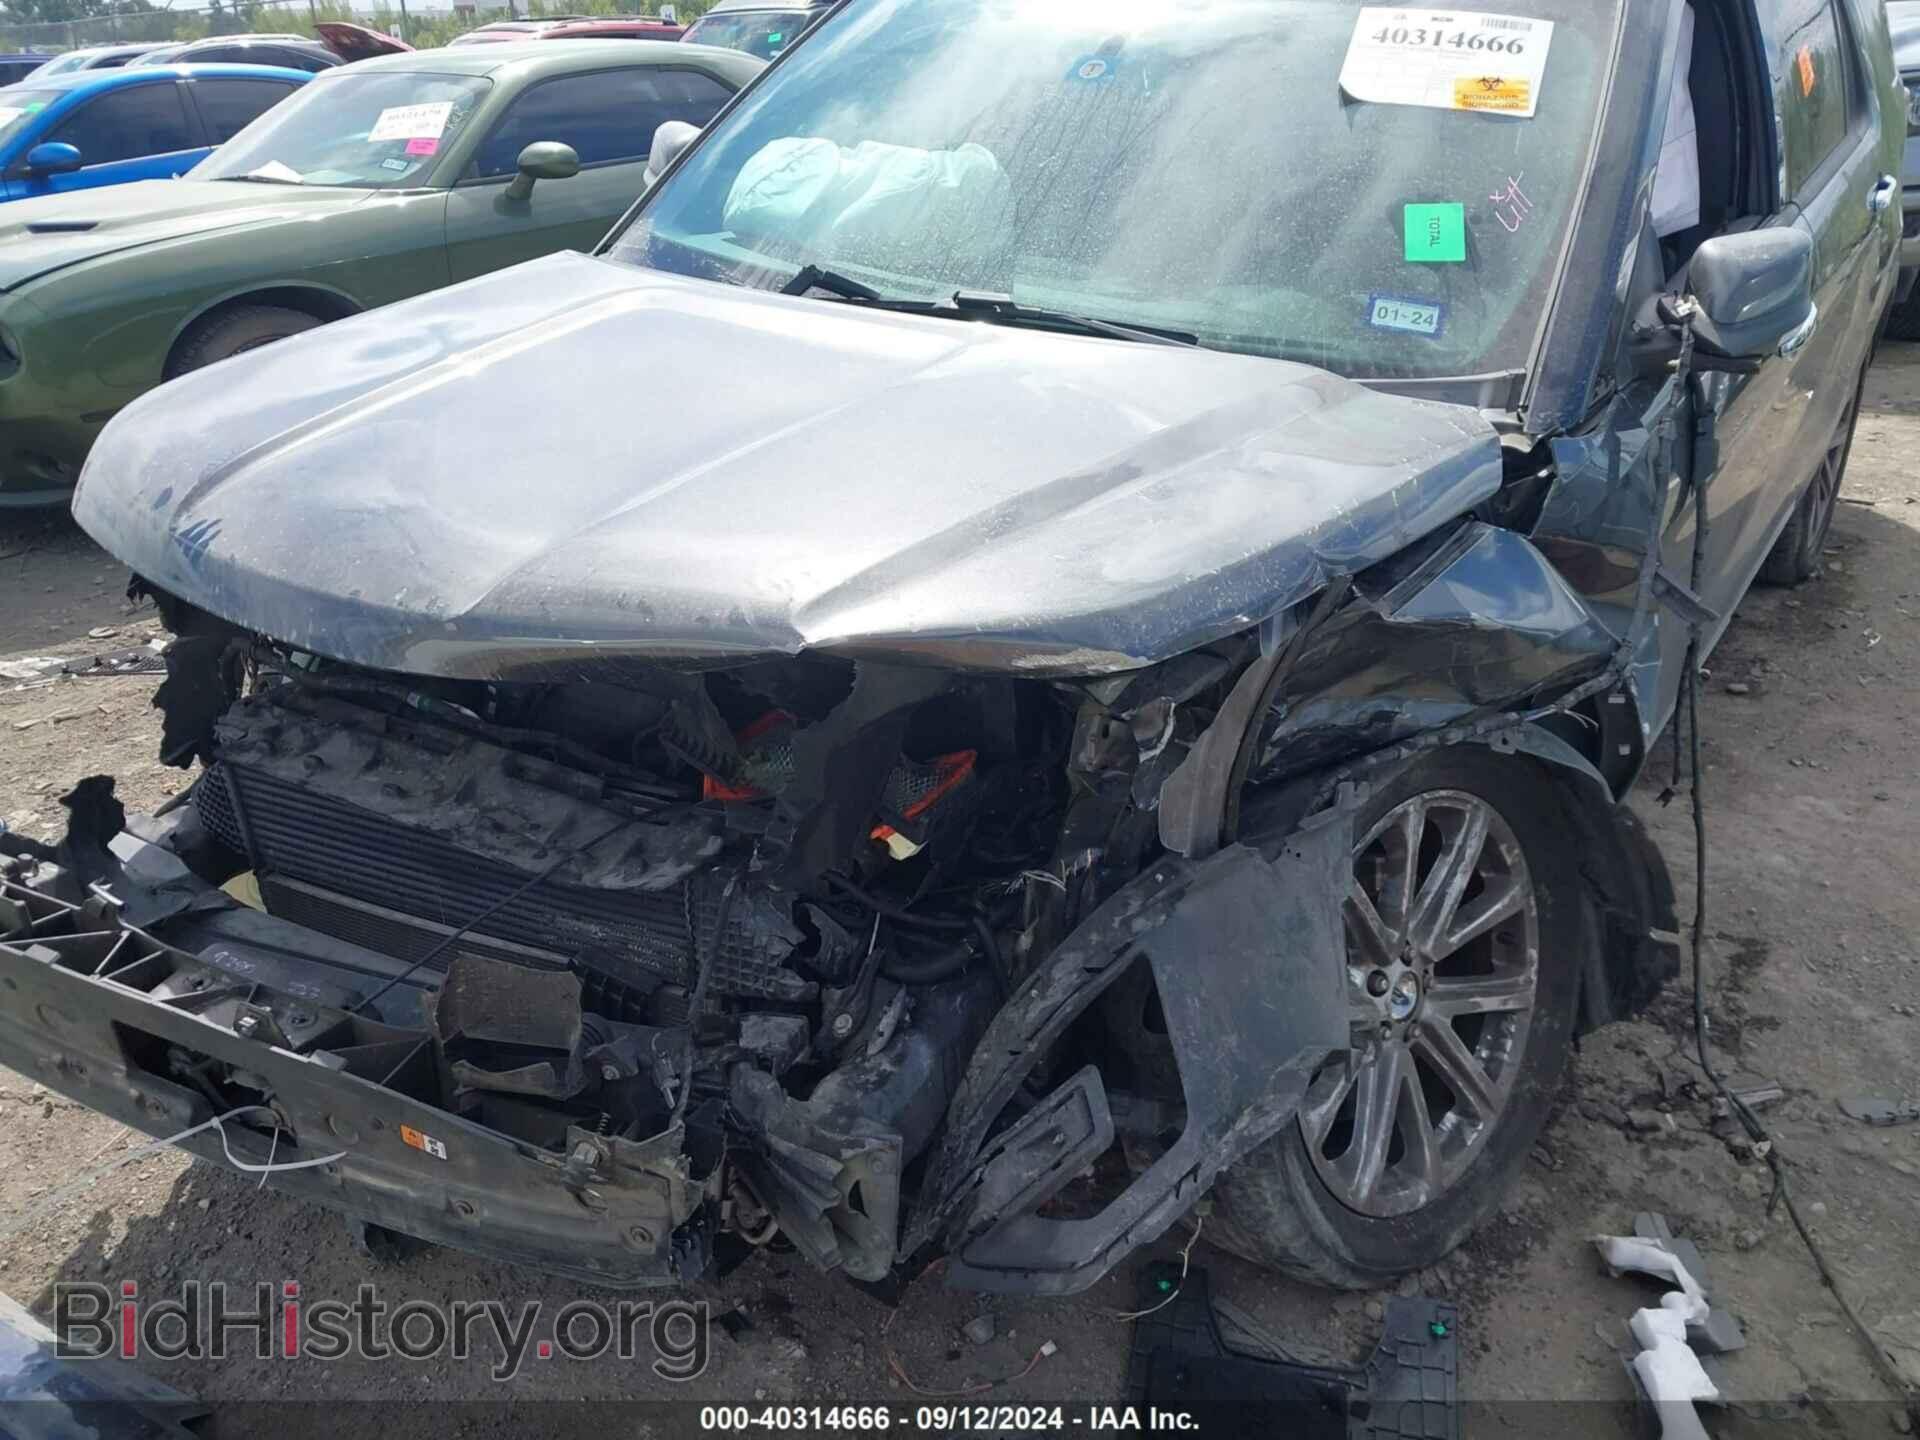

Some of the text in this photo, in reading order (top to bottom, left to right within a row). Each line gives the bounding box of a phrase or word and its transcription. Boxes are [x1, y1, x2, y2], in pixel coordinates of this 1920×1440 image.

[1372, 27, 1524, 55] 40314666
[1429, 216, 1440, 247] TOTAL
[1377, 306, 1435, 326] 01-24
